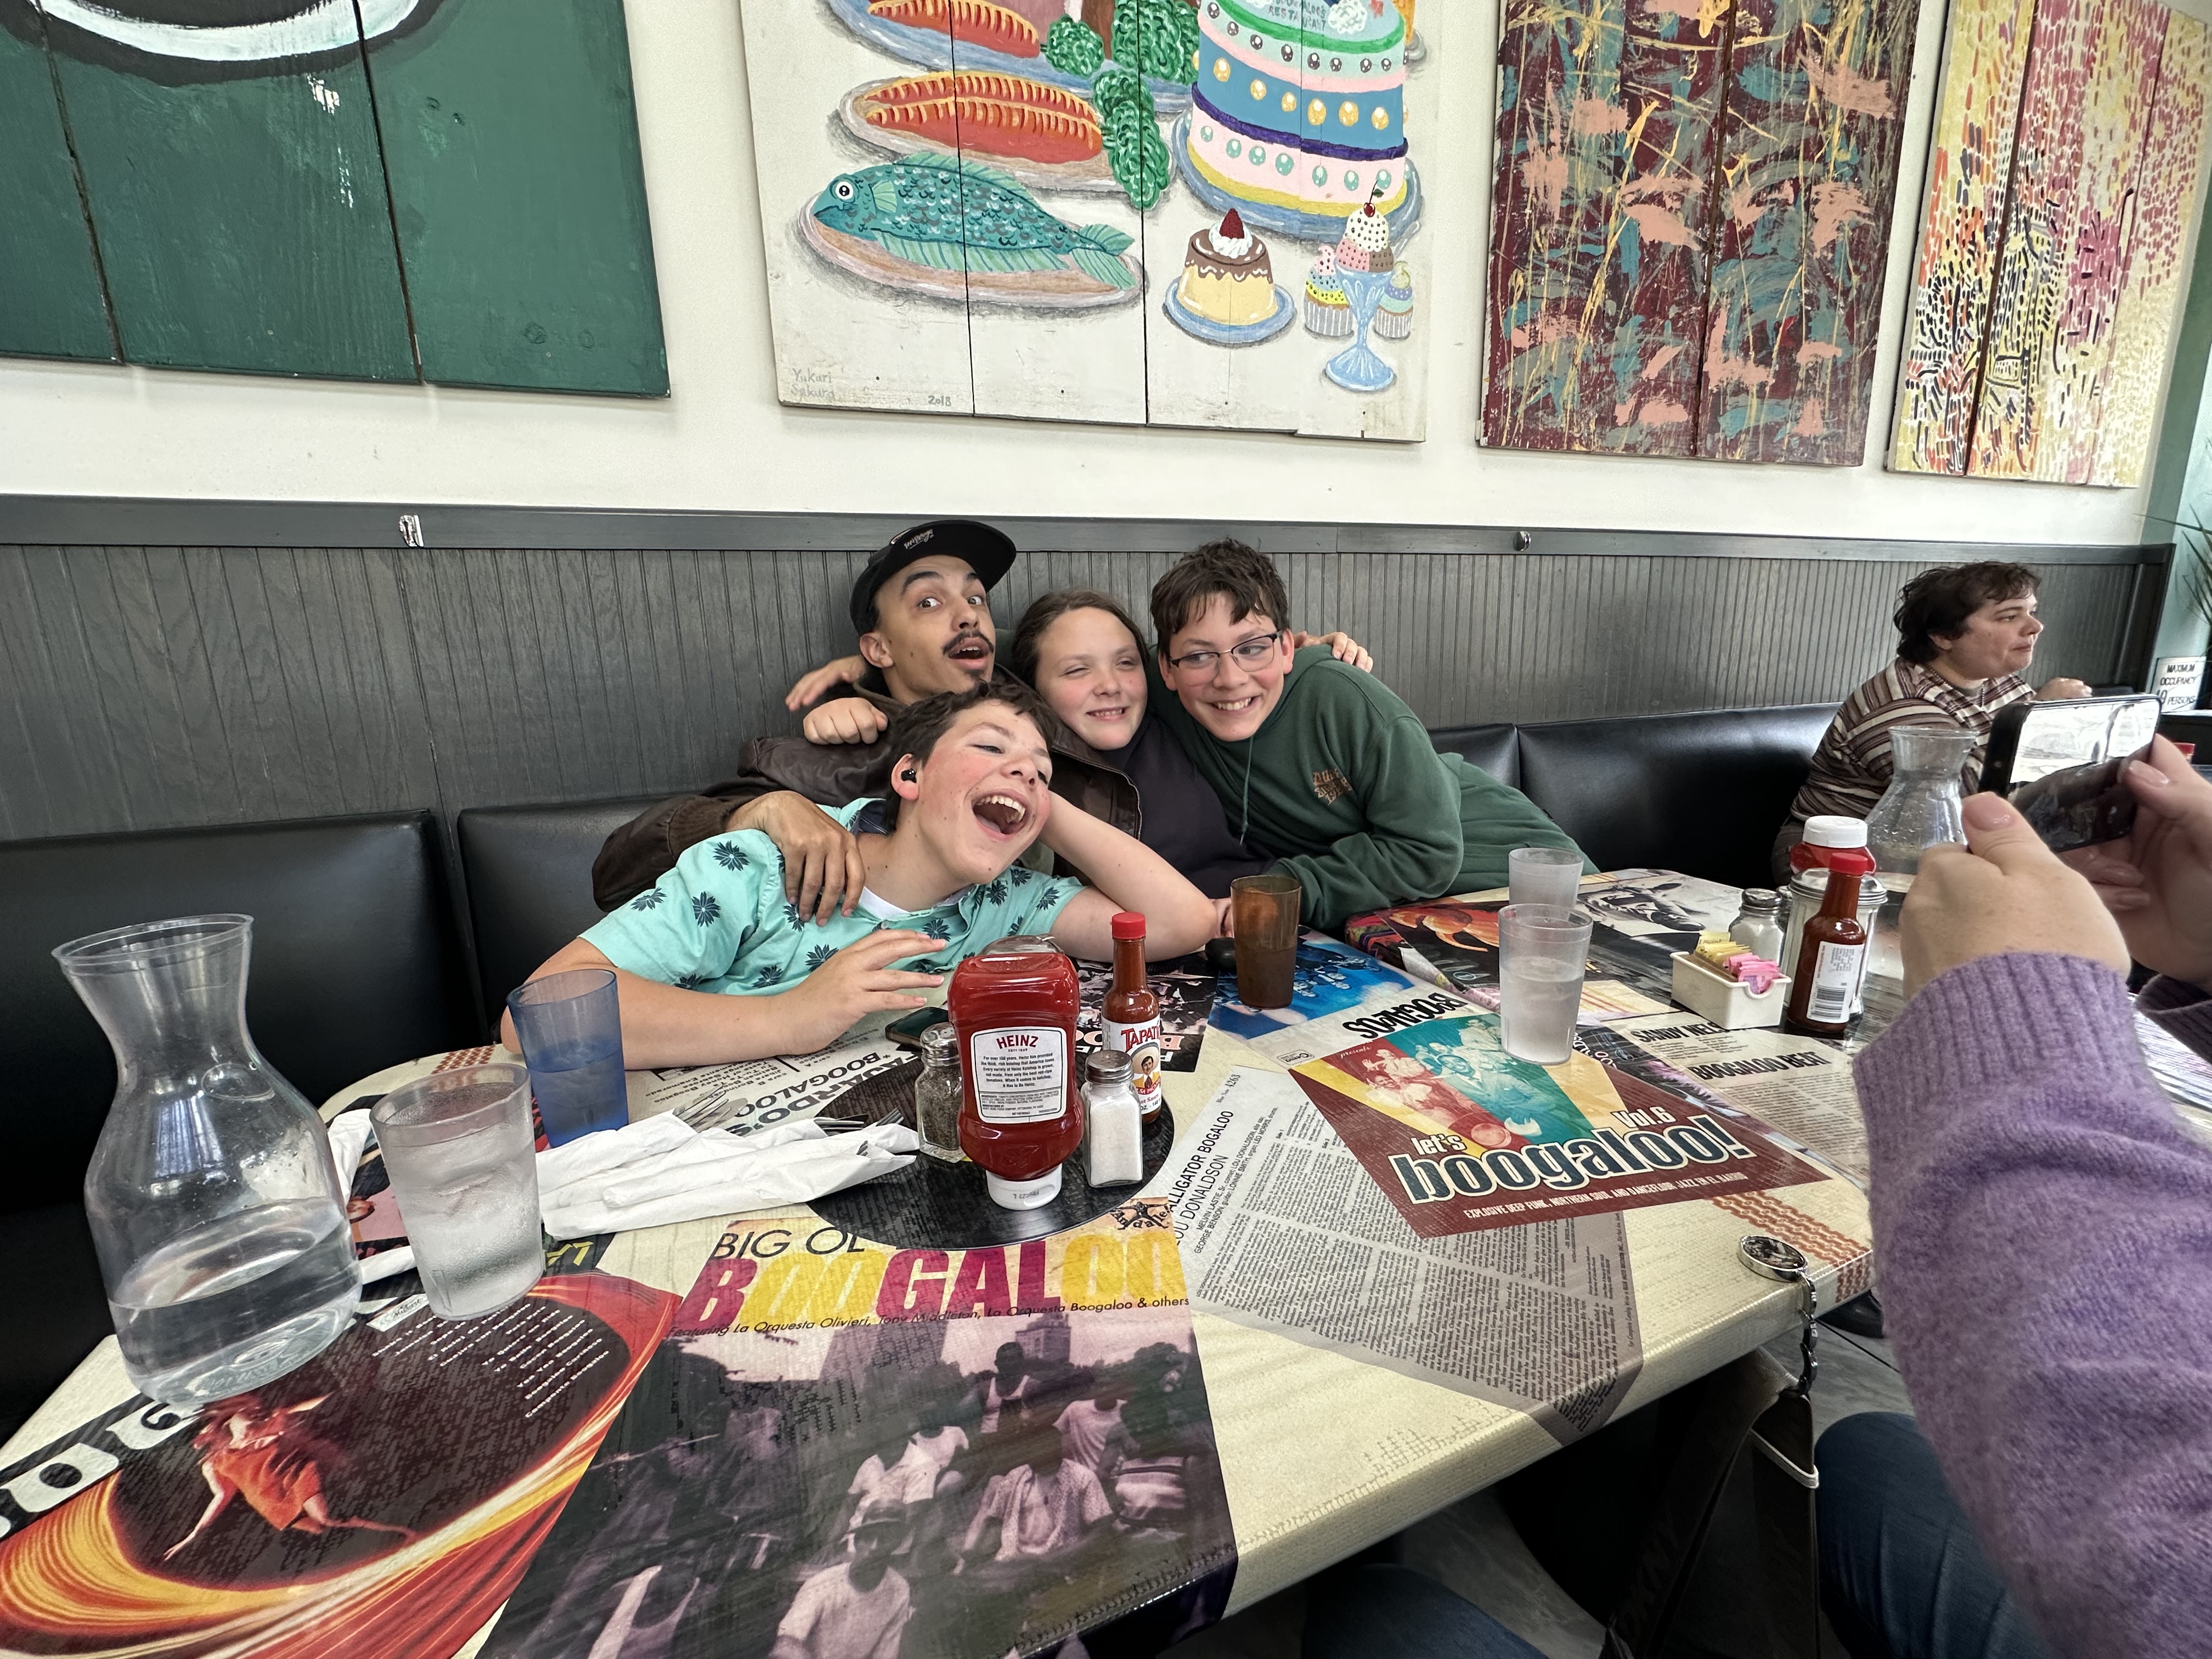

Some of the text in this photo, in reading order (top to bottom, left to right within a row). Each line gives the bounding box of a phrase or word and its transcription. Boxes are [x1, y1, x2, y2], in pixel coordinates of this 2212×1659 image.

[792, 368, 832, 383] Yukari
[928, 395, 952, 407] 2018
[2166, 664, 2195, 673] MAXIMUM
[2167, 696, 2196, 705] PERSONS
[996, 1035, 1039, 1049] HEINZ
[1630, 1026, 1688, 1043] SANDY
[1686, 1051, 1833, 1080] BOOGALOO BEAT
[654, 1086, 698, 1103] Boogaloo
[1147, 1093, 1159, 1103] Sauce
[1613, 1106, 1676, 1131] Vol.6
[1410, 1132, 1468, 1156] let's
[1166, 1110, 1234, 1212] ALLIGATOR BOGALOO
[1388, 1114, 1757, 1205] boogaloo!
[1180, 1153, 1228, 1220] DONALDSON
[1193, 1228, 1211, 1254] GEORGE
[1228, 1171, 1243, 1191] LONNIE
[1253, 1134, 1262, 1145] LEO
[1196, 1210, 1212, 1231] MELVIN
[1231, 1158, 1241, 1170] LOU
[1463, 1205, 1508, 1218] EXPLOSIVE
[1504, 1203, 1525, 1212] DEEP
[1524, 1199, 1552, 1209] FUNK,
[1548, 1193, 1592, 1206] NORTHERN
[1589, 1191, 1613, 1200] SOUL
[1610, 1188, 1629, 1197] AND
[1626, 1182, 1678, 1195] DANCEFLOOR
[1675, 1179, 1700, 1188] JAZZ
[1715, 1172, 1748, 1182] BARRIO
[711, 1229, 792, 1259] BIG
[676, 1231, 1187, 1332] BOOGALOO
[455, 1321, 466, 1329] de
[505, 1305, 546, 1335] Pata Pata
[666, 1295, 1190, 1338] Featuring La Orquesta Olivieri, Tony Middleton, La Orquesta Boogaloo & others
[371, 1336, 402, 1357] Shake
[393, 1329, 433, 1357] Jamaica
[439, 1302, 531, 1368] Guajira con Boogaloo
[440, 1334, 465, 1353] Reloj
[467, 1325, 478, 1334] de
[494, 1363, 507, 1373] Yo
[535, 1314, 573, 1343] Boogaloo
[546, 1318, 586, 1349] Boogaloo
[555, 1327, 594, 1358] Boogaloo
[482, 1356, 495, 1367] Yo
[496, 1334, 526, 1356] Quiero
[569, 1349, 610, 1381] Boogaloo
[524, 1366, 566, 1400] Boogaloo
